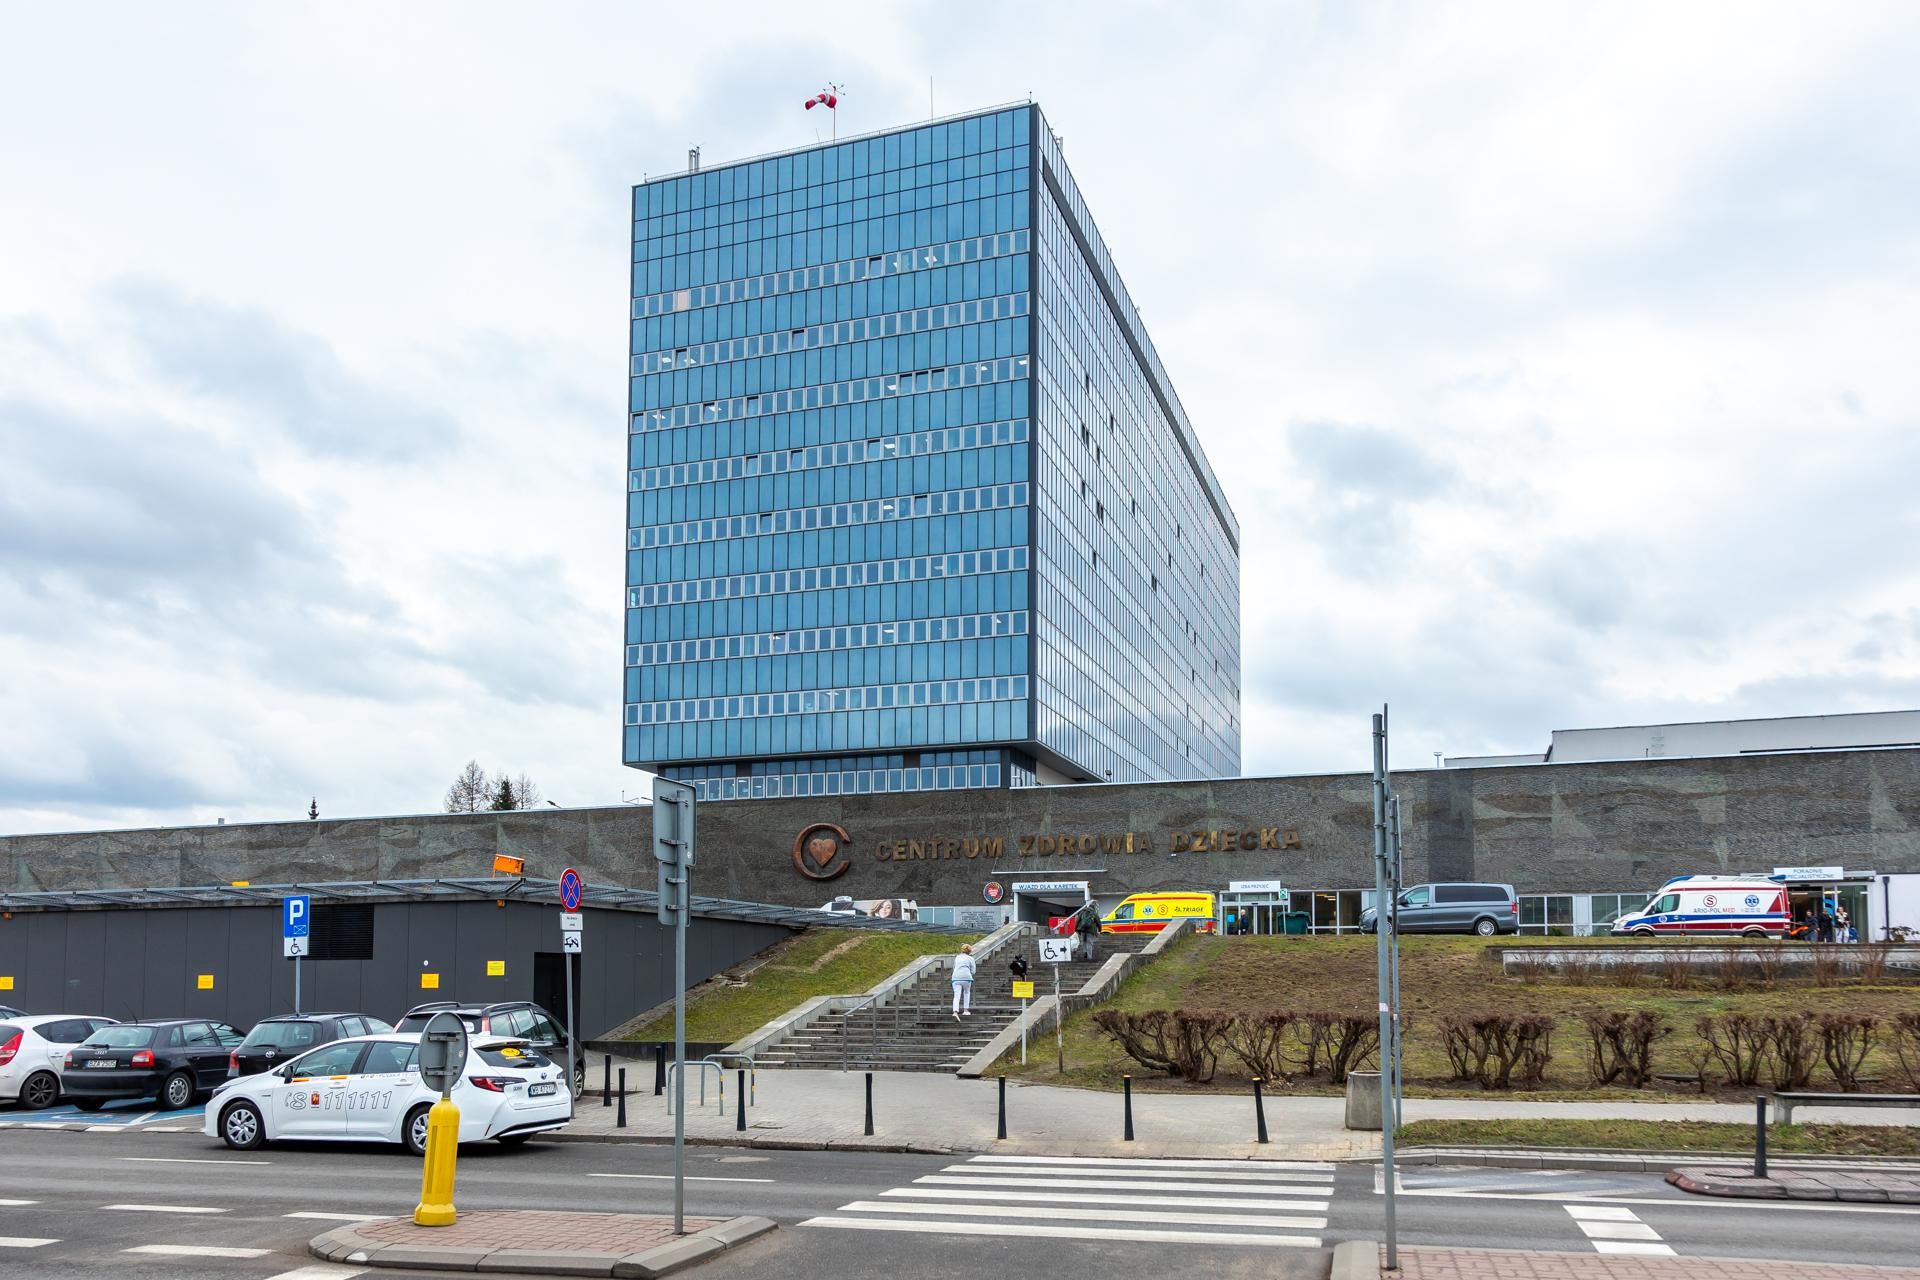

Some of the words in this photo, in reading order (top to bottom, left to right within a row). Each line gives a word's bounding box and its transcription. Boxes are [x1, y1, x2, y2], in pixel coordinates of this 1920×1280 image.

[874, 836, 1004, 862] CENTRUM
[1018, 831, 1153, 857] ZDROWIA
[1168, 826, 1302, 852] DZIECKA
[1706, 896, 1714, 906] S
[290, 900, 304, 925] P
[289, 1091, 307, 1110] 8
[324, 1090, 393, 1110] 111111
